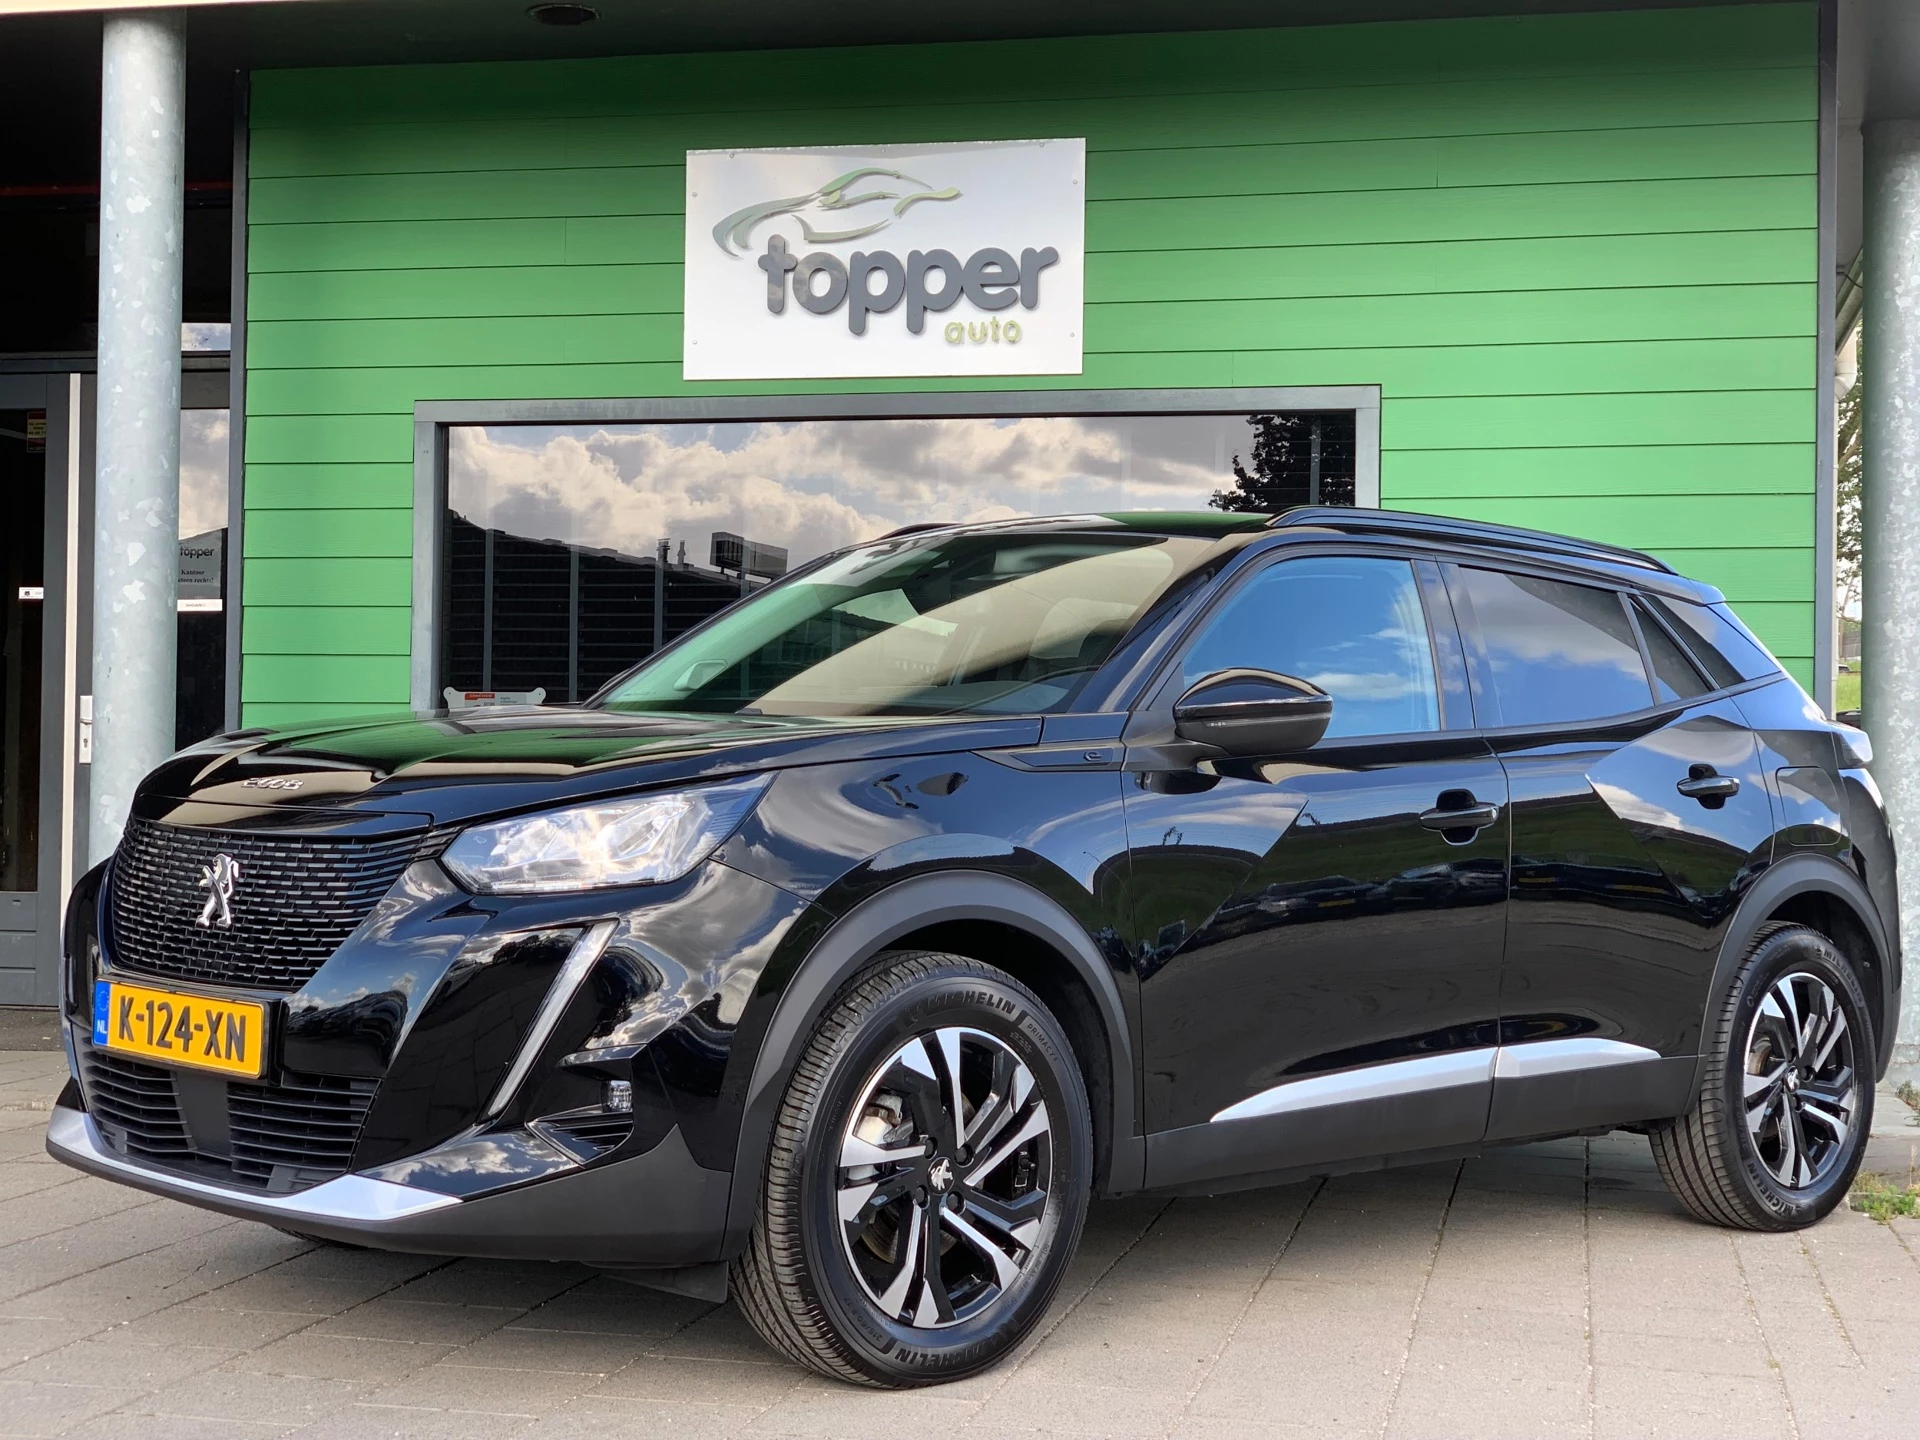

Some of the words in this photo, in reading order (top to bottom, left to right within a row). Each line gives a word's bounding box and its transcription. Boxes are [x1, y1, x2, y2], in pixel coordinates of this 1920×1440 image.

[757, 233, 1060, 335] topper
[944, 315, 1022, 344] auto
[180, 546, 215, 559] topper
[96, 1019, 108, 1035] NL
[118, 994, 247, 1063] K-124-XN
[1026, 1022, 1056, 1058] PRIMACY
[1748, 1161, 1796, 1215] MICHELIN
